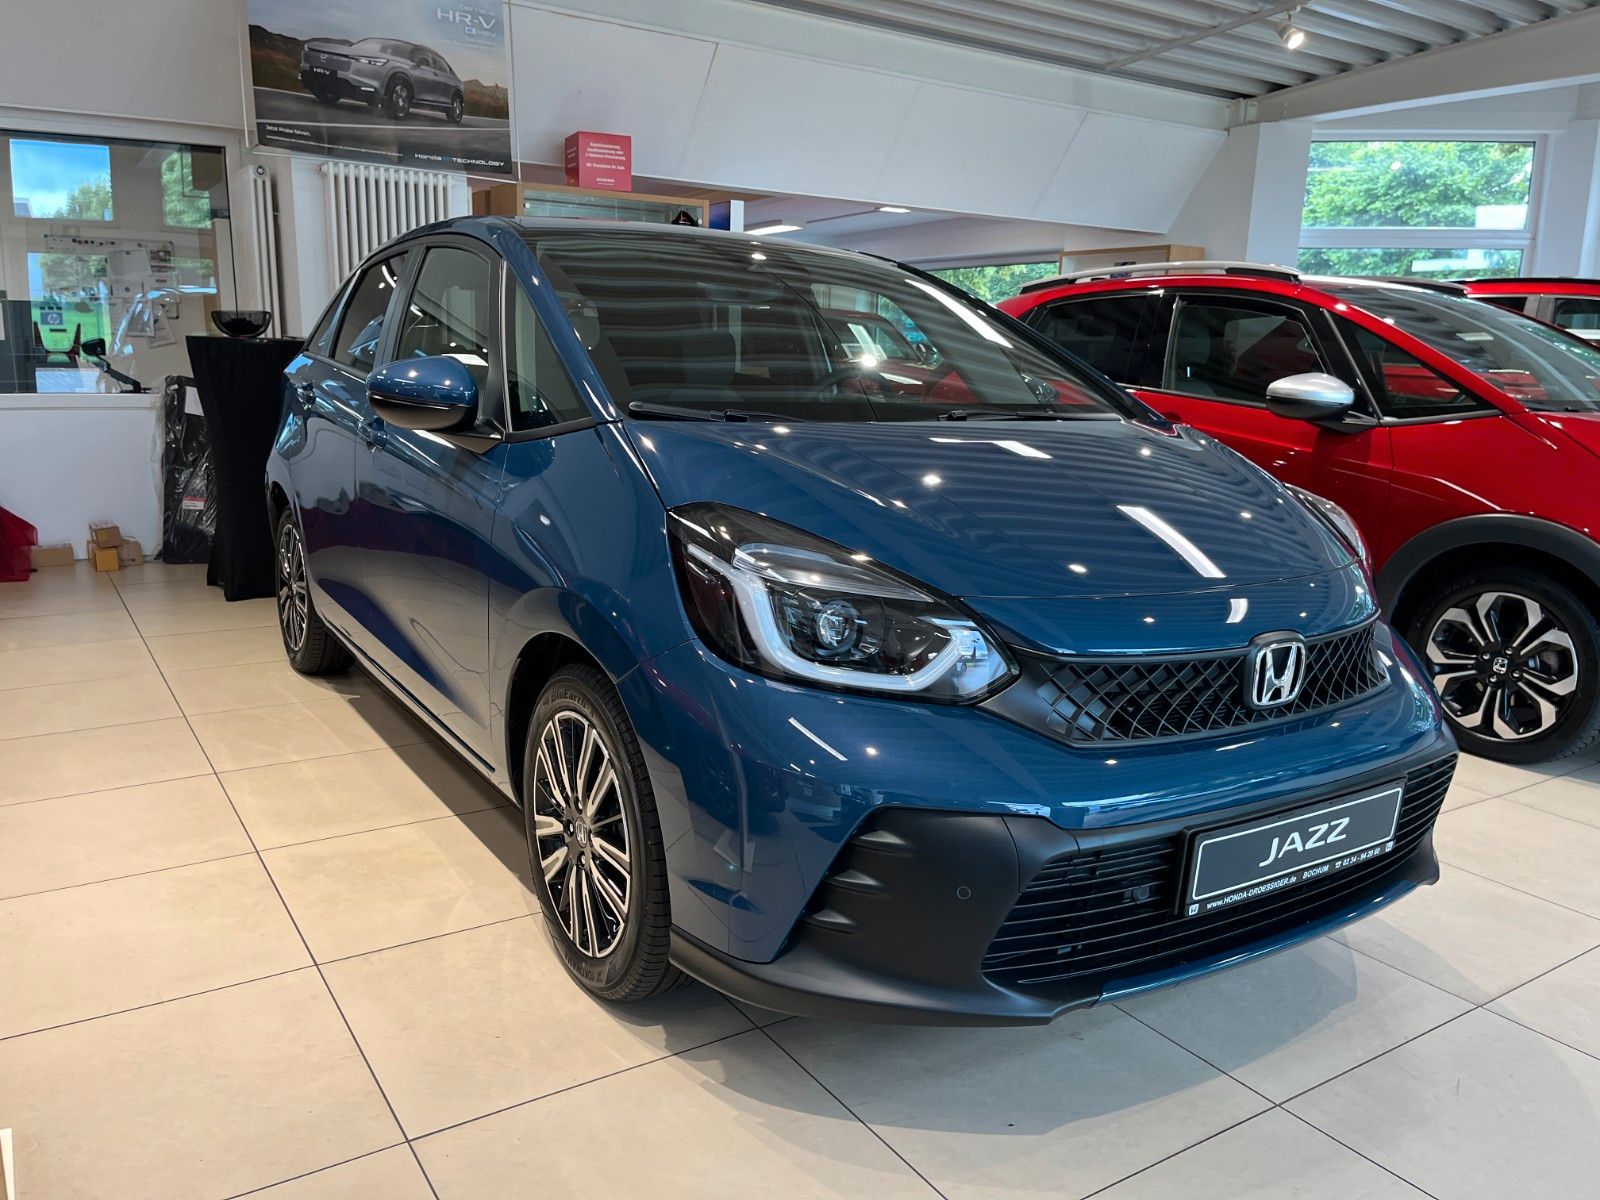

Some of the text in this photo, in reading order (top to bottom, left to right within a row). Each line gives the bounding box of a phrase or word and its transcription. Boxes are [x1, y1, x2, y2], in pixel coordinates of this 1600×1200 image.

[437, 8, 496, 29] HR-V
[414, 153, 442, 161] Honda
[1259, 817, 1350, 868] JAZZ
[1302, 864, 1330, 879] BOCHUM
